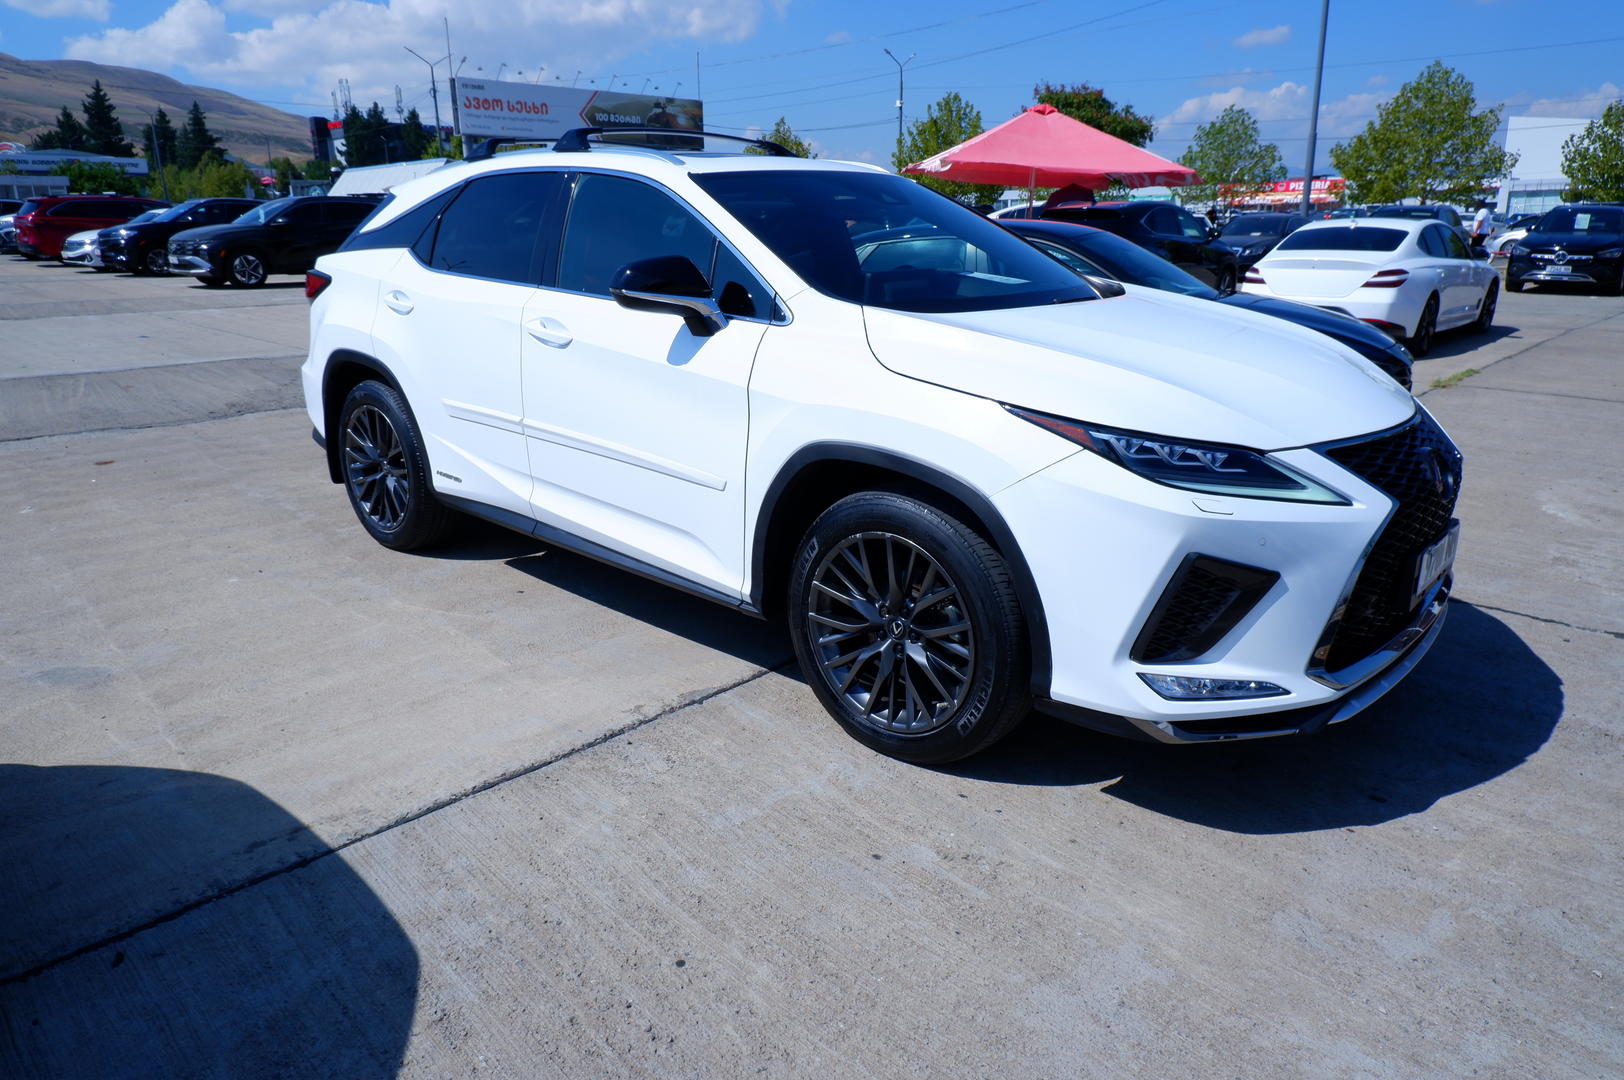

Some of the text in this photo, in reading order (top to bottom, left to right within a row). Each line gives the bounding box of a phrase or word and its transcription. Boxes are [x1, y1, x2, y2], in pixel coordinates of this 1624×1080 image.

[464, 96, 549, 115] ავტო სესხი
[595, 112, 609, 122] 100
[1289, 180, 1331, 191] PIZERIA
